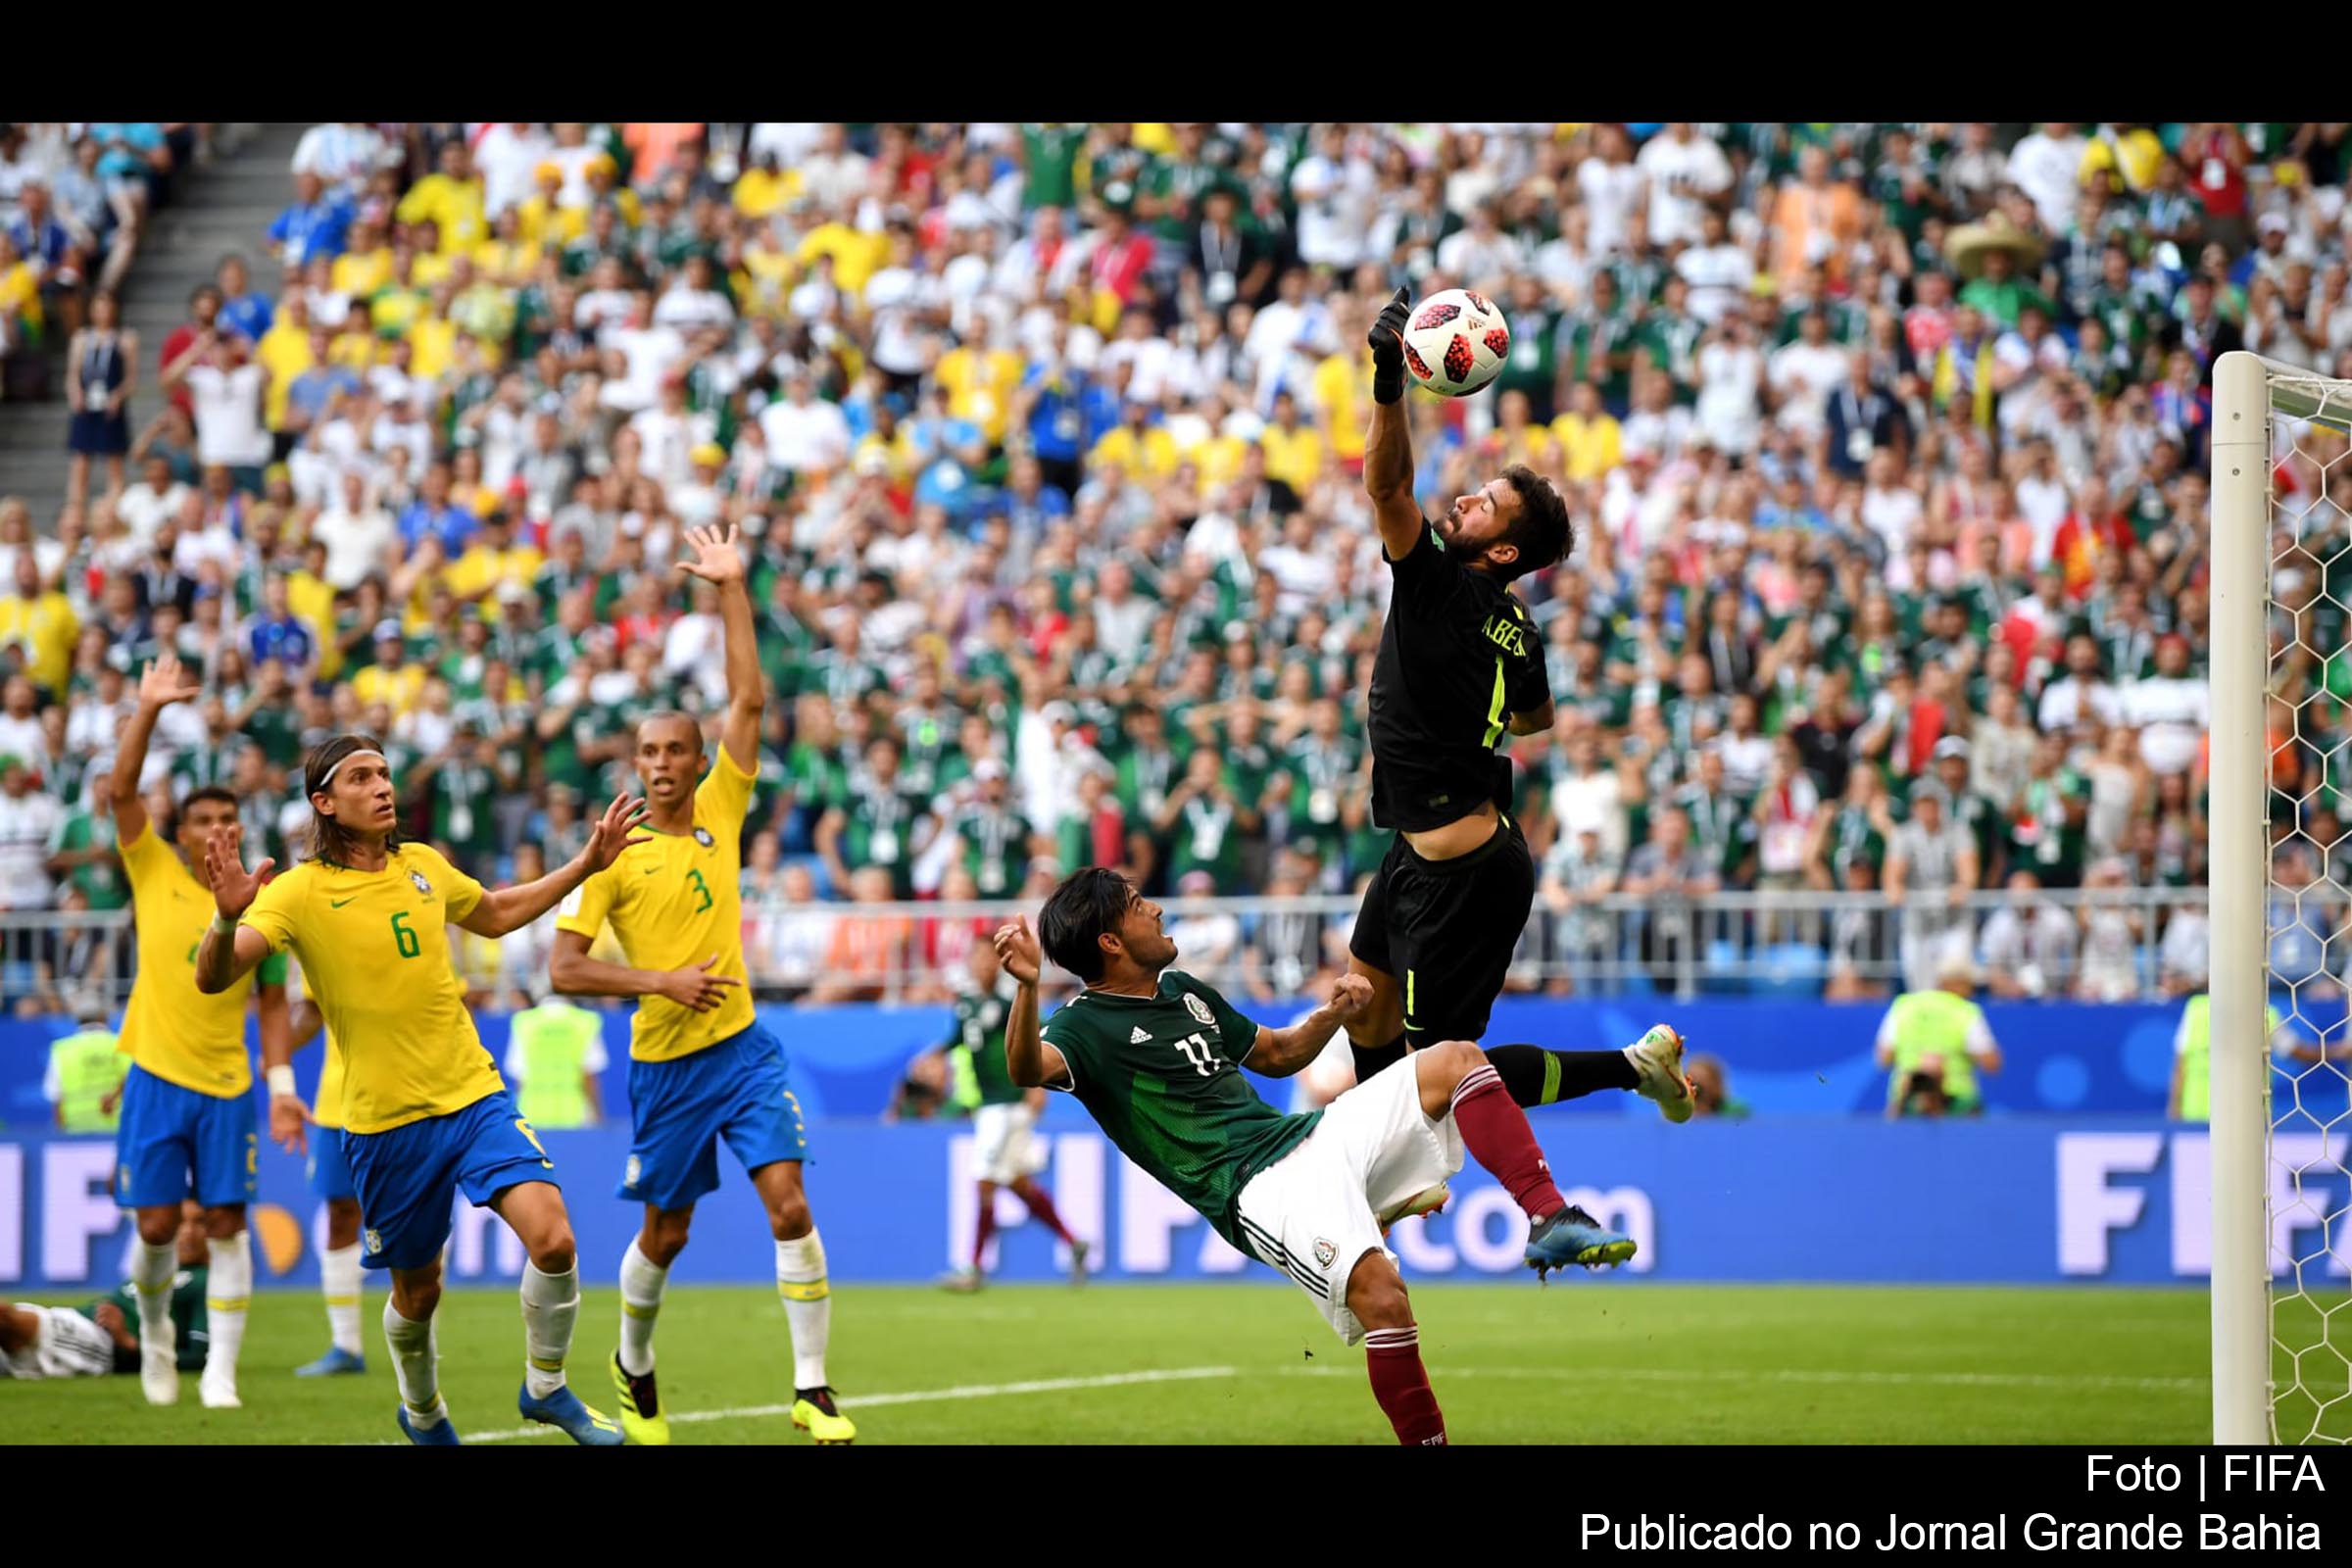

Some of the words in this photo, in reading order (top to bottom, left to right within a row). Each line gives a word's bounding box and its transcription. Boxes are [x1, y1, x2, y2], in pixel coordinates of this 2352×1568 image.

[685, 868, 713, 914] 3
[391, 911, 420, 958] 6
[1174, 1033, 1221, 1077] 11
[2057, 1132, 2352, 1276] FIF
